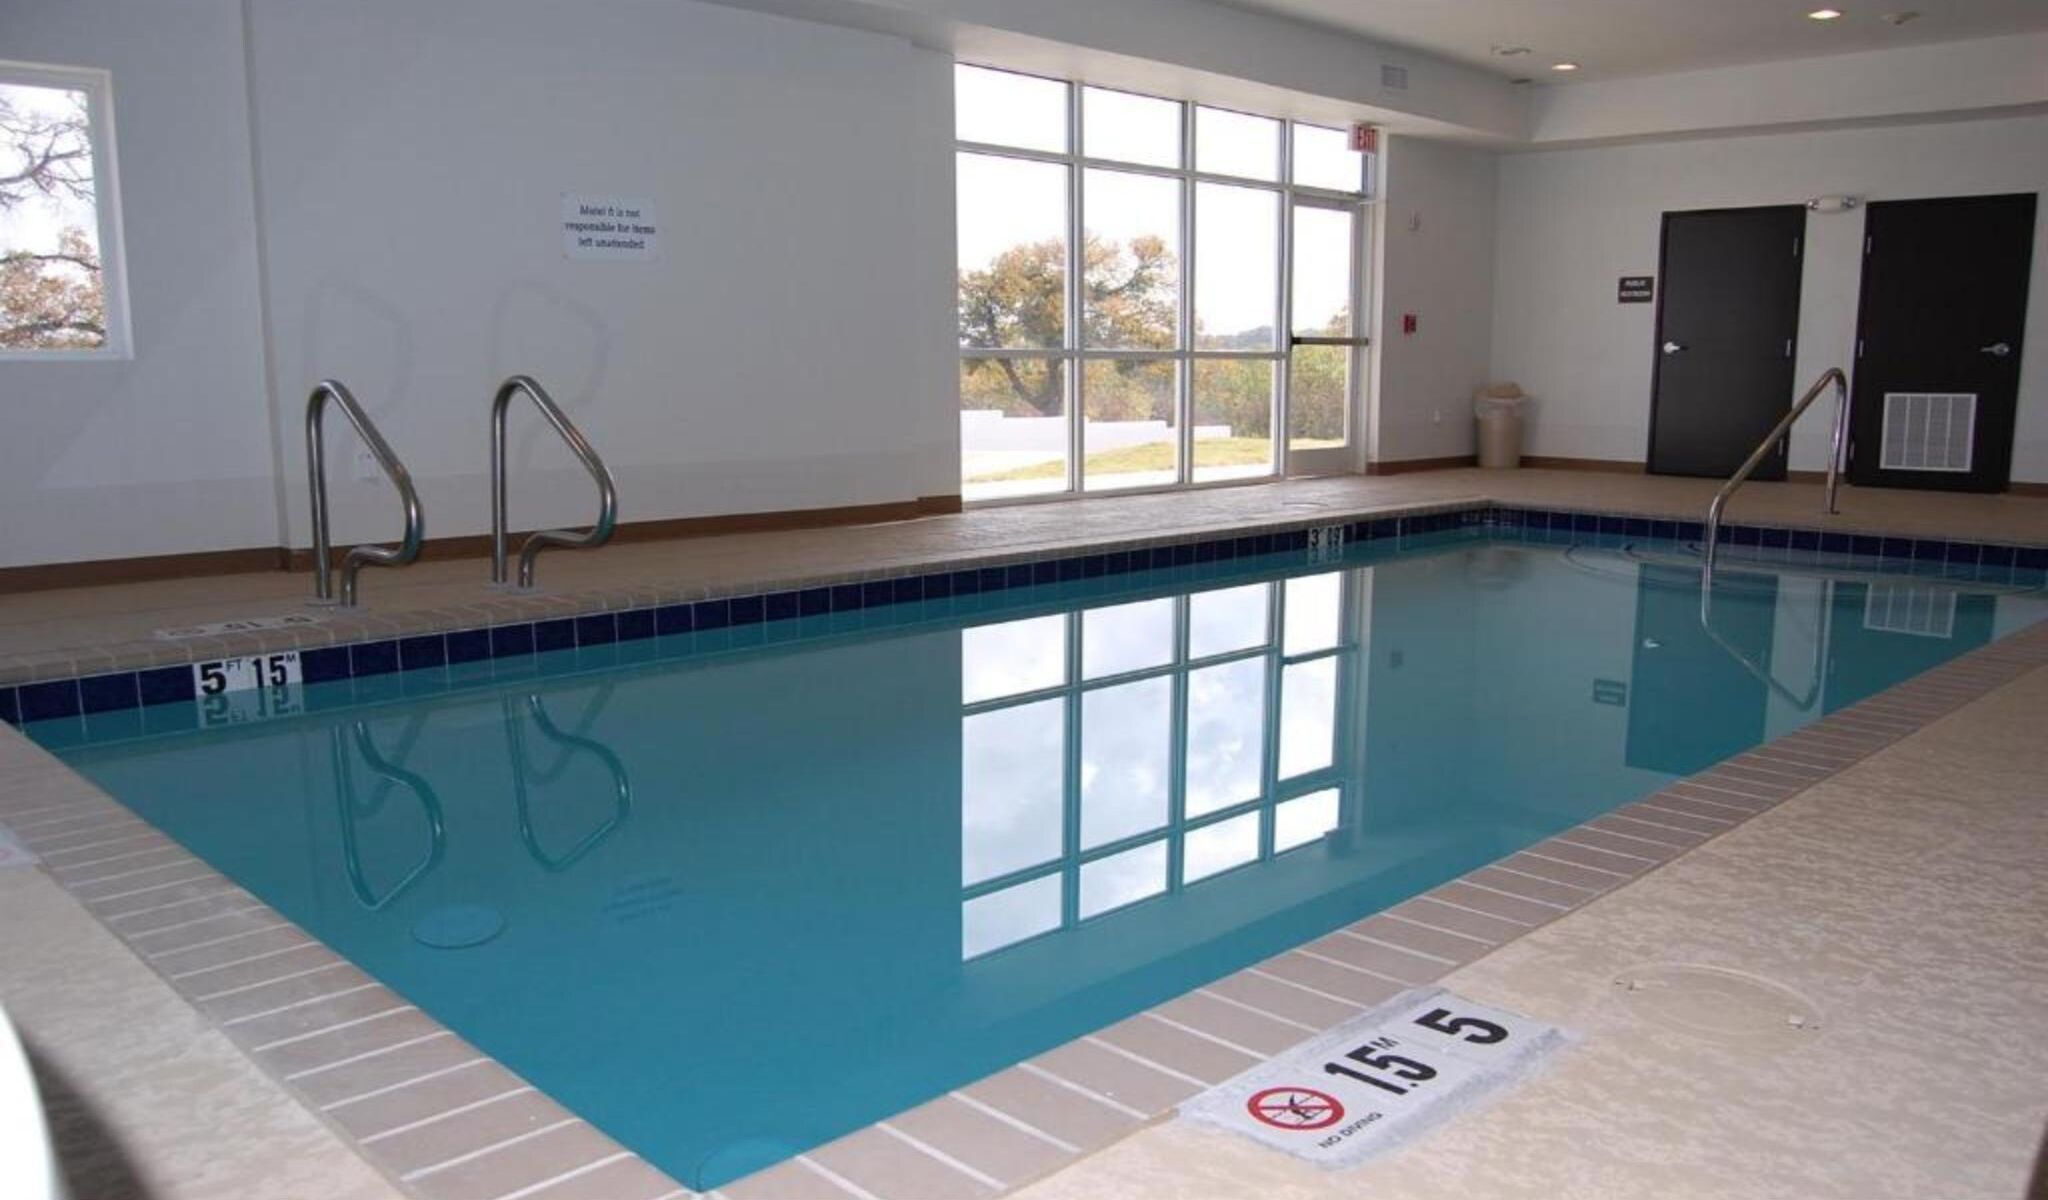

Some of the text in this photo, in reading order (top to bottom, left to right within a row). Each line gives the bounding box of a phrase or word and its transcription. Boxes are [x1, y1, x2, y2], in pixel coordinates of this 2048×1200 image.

[1357, 126, 1376, 149] EXIT
[565, 222, 615, 233] responsible
[617, 223, 630, 233] for
[578, 237, 593, 247] left
[1413, 1008, 1509, 1044] 5
[1318, 1112, 1383, 1149] NO DIVING
